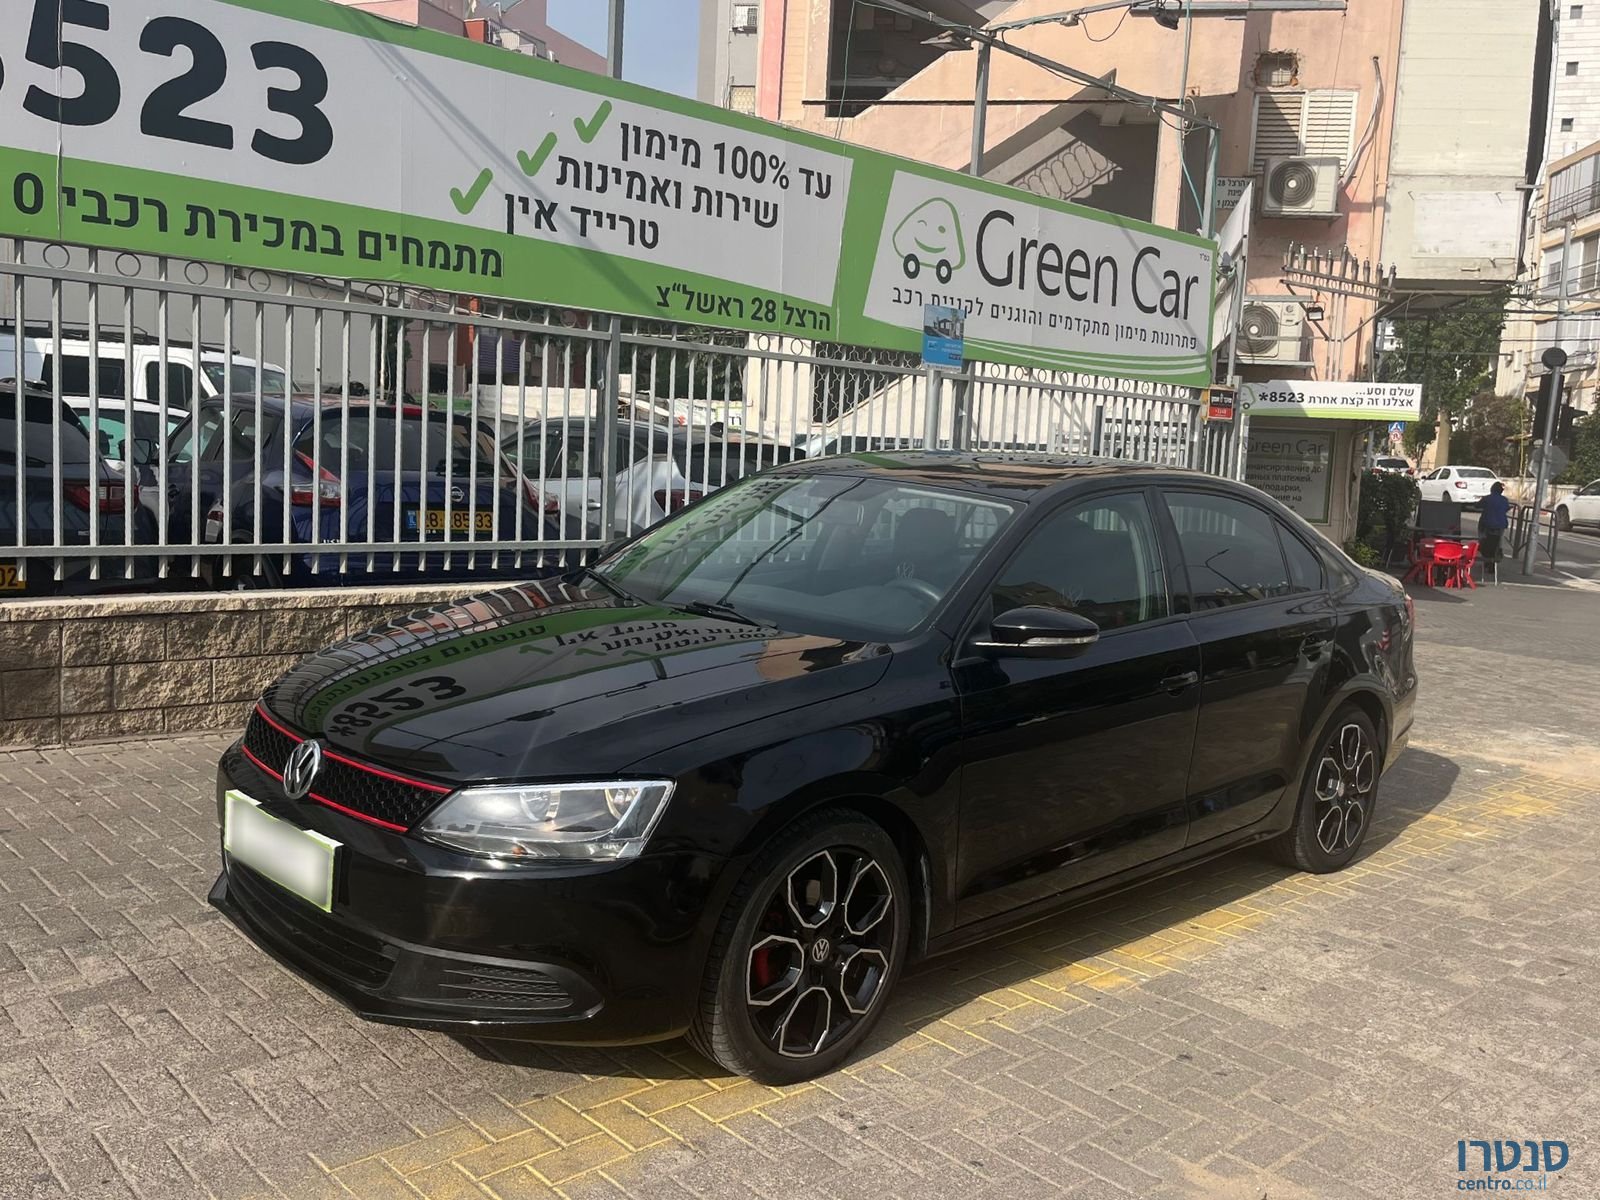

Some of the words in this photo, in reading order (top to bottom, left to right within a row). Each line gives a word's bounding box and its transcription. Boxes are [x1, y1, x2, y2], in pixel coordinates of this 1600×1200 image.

[0, 0, 333, 165] 523
[620, 122, 702, 169] מימון
[713, 142, 790, 190] 100%
[13, 172, 44, 214] 0
[557, 155, 682, 210] ואמינות
[799, 168, 832, 200] עד
[1217, 179, 1226, 187] 28
[62, 187, 167, 233] רכבי
[505, 192, 558, 234] אין
[692, 185, 778, 229] שירות
[1222, 199, 1238, 208] יצמן
[185, 203, 344, 256] במכירת
[571, 205, 659, 249] טרייד
[358, 229, 503, 278] מתמחים
[975, 209, 1118, 306] Green
[1131, 246, 1199, 321] Car
[892, 286, 922, 306] רכב
[751, 297, 777, 323] 28
[783, 301, 831, 331] הרצל
[991, 304, 1042, 326] והוגנים
[1049, 313, 1109, 337] מתקדמים
[1115, 323, 1147, 342] מימון
[1152, 330, 1197, 350] פתרונות
[1309, 396, 1338, 405] אחרת
[1340, 396, 1365, 408] קצת
[1367, 398, 1380, 406] זה
[1383, 398, 1413, 407] אצלנו
[1390, 386, 1415, 396] שלם
[1296, 439, 1323, 455] Car
[1246, 463, 1309, 474] инансирование
